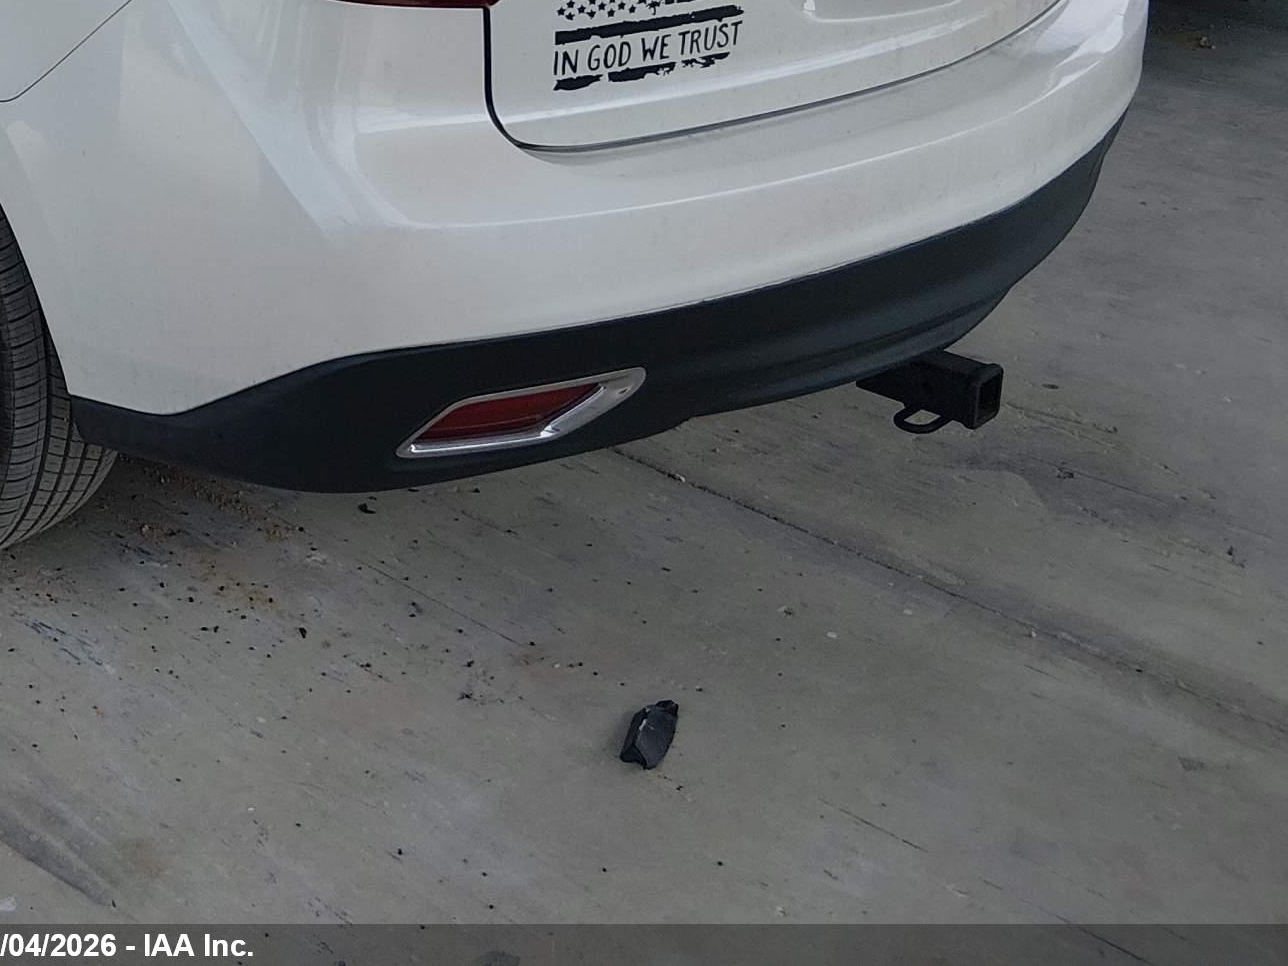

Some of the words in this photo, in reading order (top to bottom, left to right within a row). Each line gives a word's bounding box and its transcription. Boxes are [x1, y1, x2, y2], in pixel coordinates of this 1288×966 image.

[553, 49, 579, 76] IN
[587, 41, 632, 71] GOD
[641, 33, 672, 62] WE
[678, 20, 743, 56] TRUST
